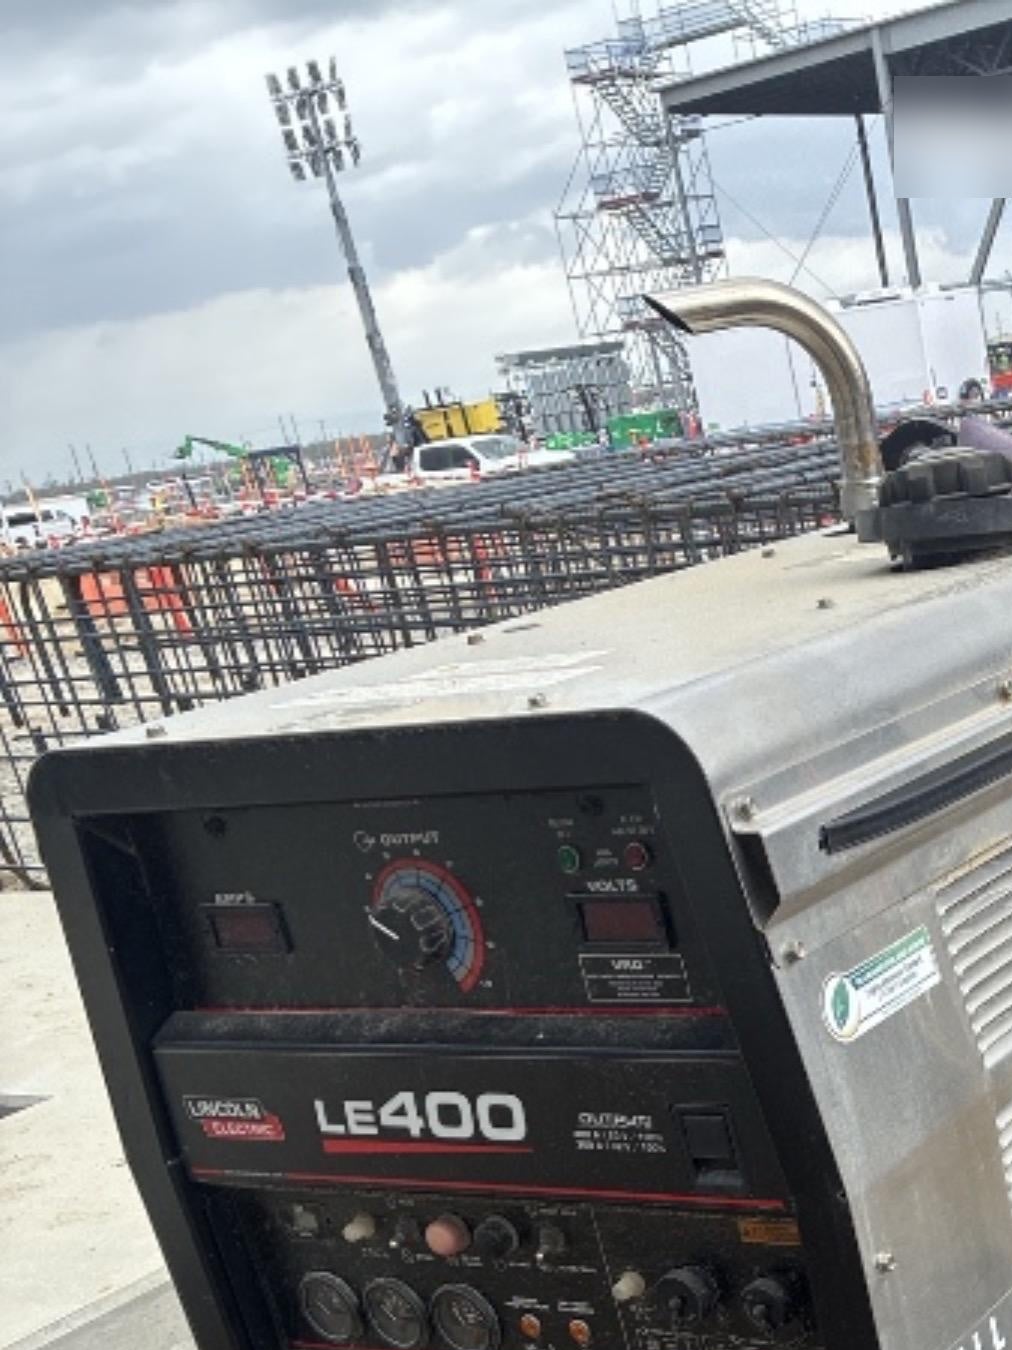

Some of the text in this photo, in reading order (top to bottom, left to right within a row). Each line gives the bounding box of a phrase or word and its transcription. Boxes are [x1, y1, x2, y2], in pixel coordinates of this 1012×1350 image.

[586, 878, 639, 894] VOLTS
[188, 1099, 262, 1120] LINCOLN
[314, 1090, 528, 1142] LE400
